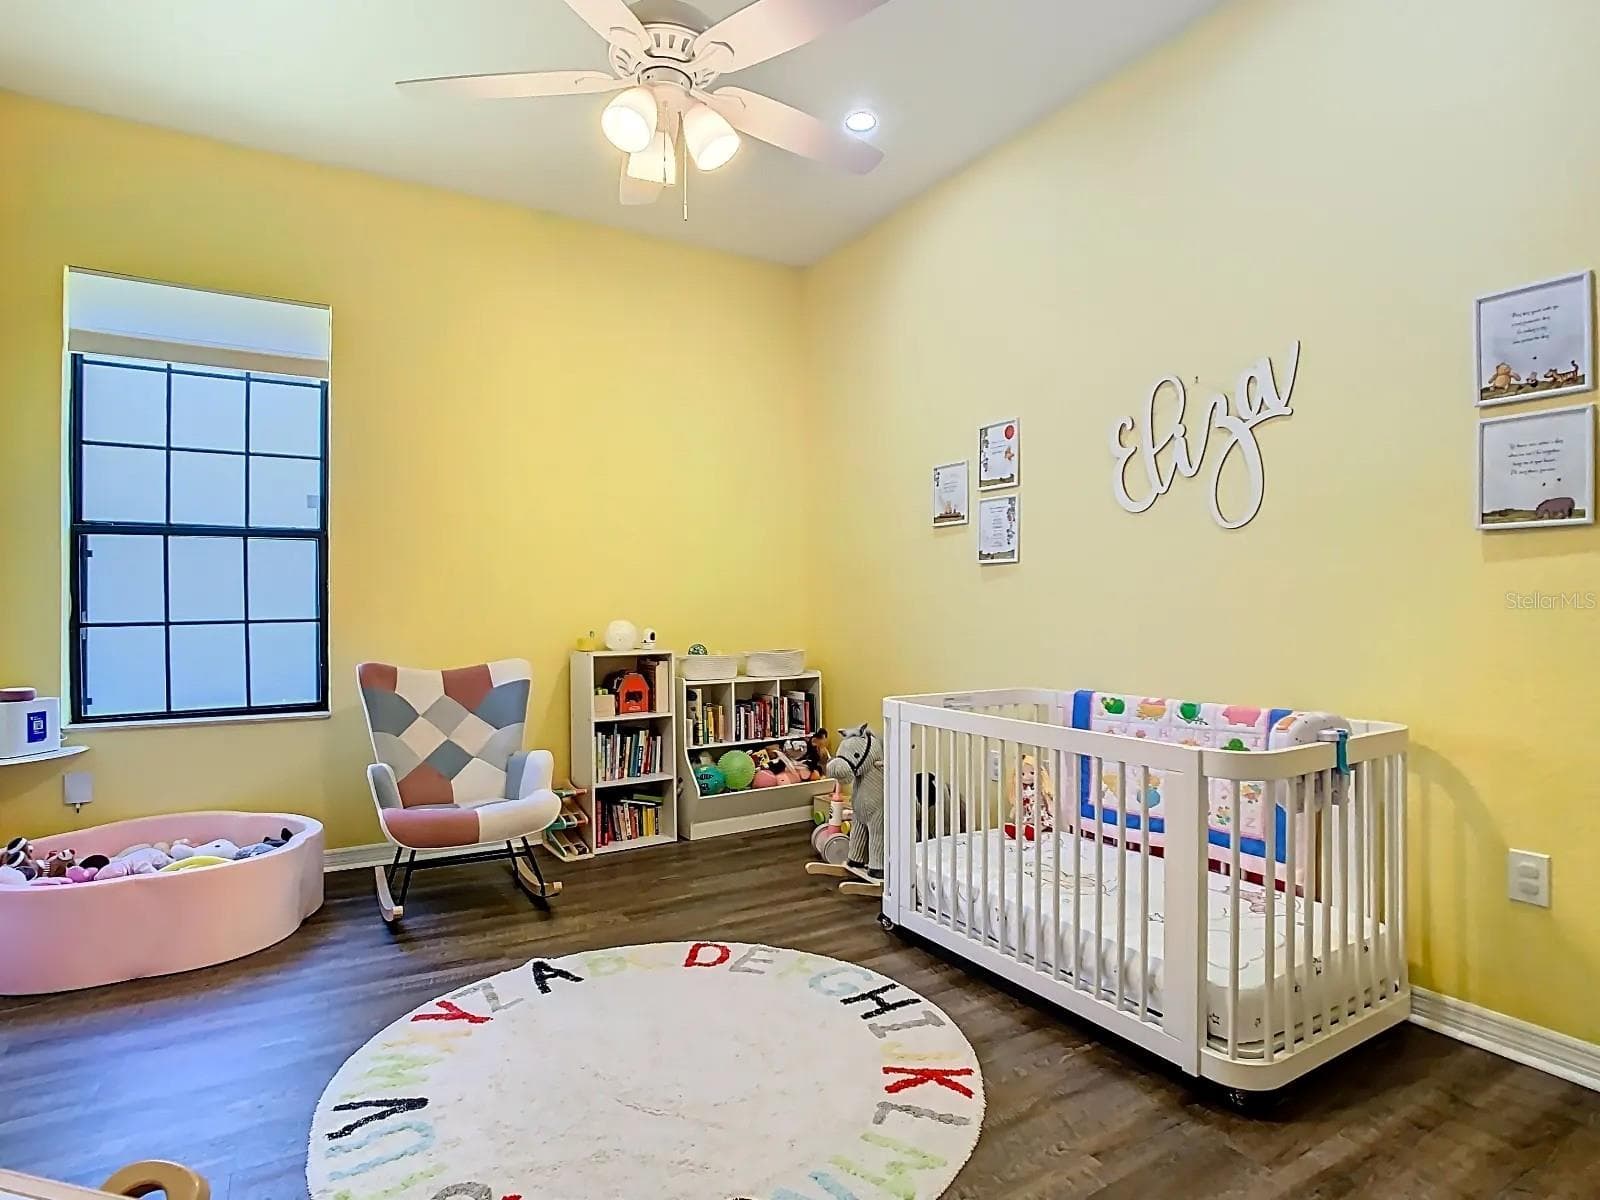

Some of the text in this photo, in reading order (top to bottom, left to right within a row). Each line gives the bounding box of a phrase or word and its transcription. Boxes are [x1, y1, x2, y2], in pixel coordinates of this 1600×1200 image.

[1108, 339, 1301, 530] Eliza
[681, 943, 731, 968] D
[532, 960, 585, 995] A
[840, 982, 923, 1021] H
[882, 1066, 976, 1099] K
